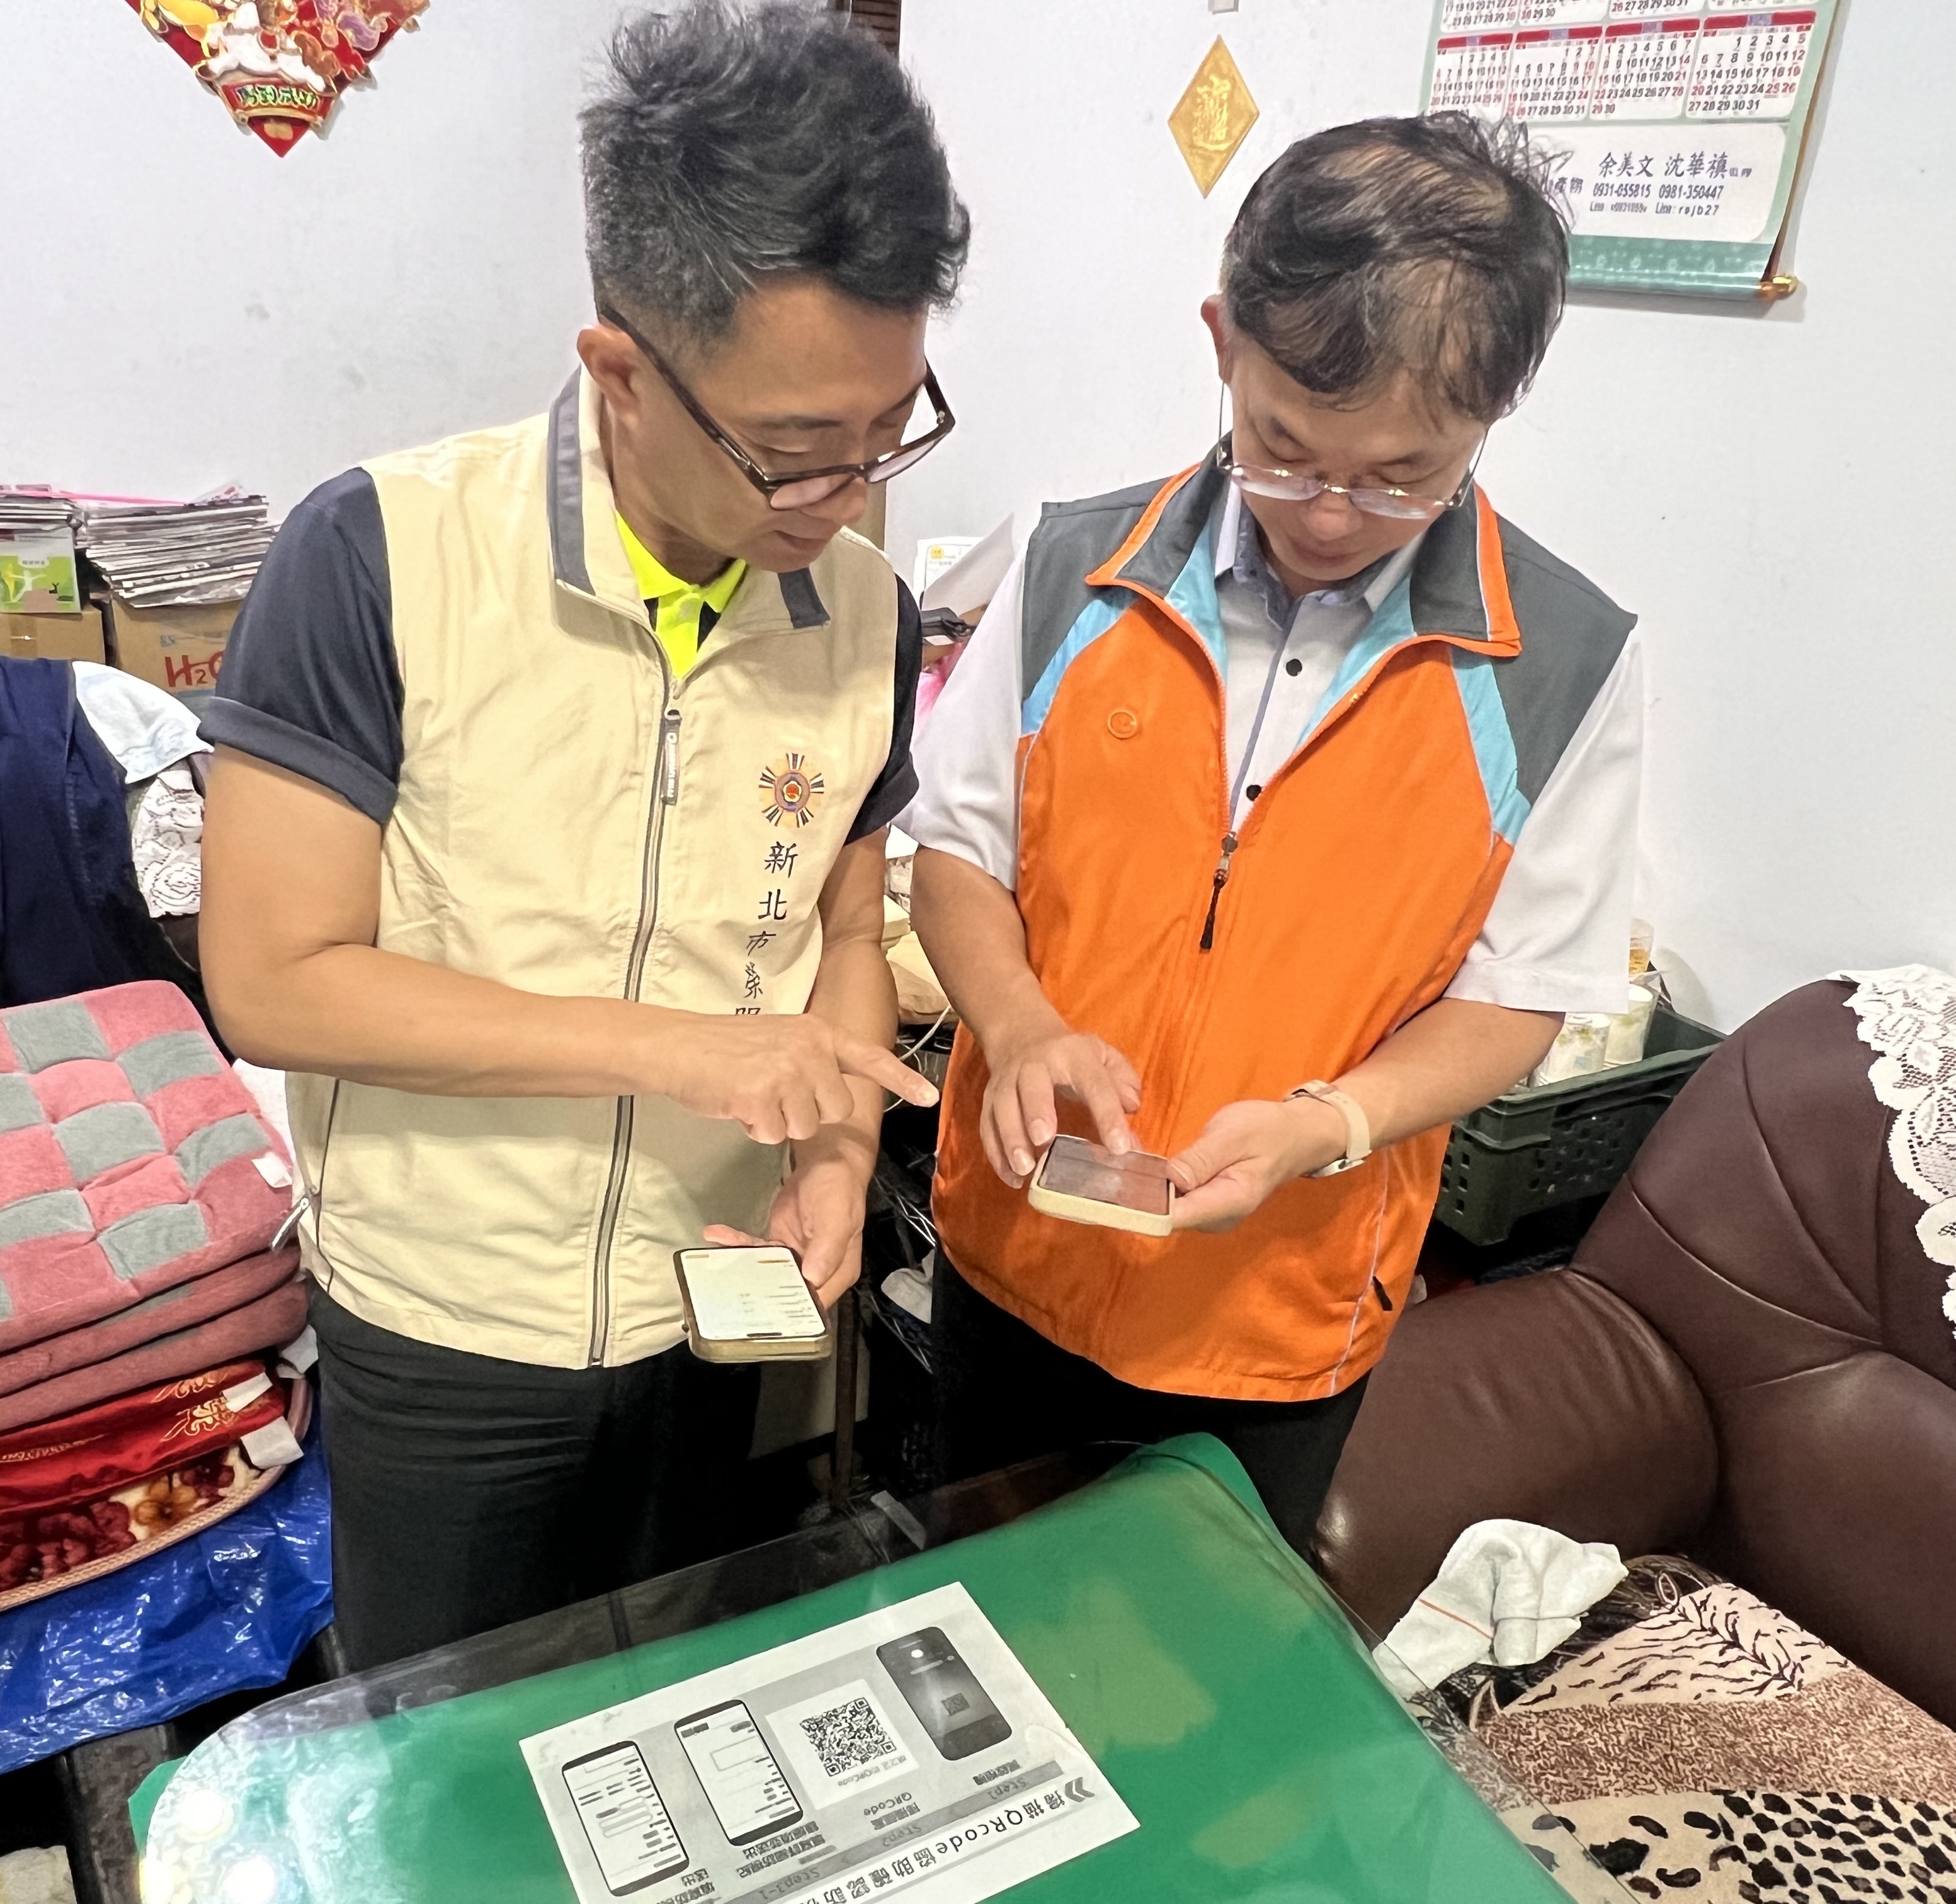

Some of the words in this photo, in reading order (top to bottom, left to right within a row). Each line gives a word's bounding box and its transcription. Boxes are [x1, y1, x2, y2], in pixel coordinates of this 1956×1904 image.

[1736, 36, 1742, 47] 1
[1749, 35, 1759, 46] 2
[1766, 35, 1774, 45] 3
[1782, 33, 1790, 43] 4
[1797, 32, 1807, 43] 5
[1701, 54, 1709, 64] 6
[1717, 53, 1724, 64] 7
[1730, 52, 1739, 63] 8
[1746, 52, 1754, 62] 9
[1760, 50, 1773, 62] 10
[1775, 50, 1789, 61] 11
[1792, 49, 1806, 60] 12
[1695, 69, 1708, 80] 13
[1710, 69, 1723, 79] 14
[1725, 68, 1739, 79] 15
[1740, 67, 1753, 78] 16
[1756, 67, 1770, 77] 17
[1691, 85, 1705, 96] 20
[1705, 84, 1719, 95] 21
[1719, 84, 1735, 94] 22
[1734, 83, 1749, 94] 23
[1749, 83, 1765, 94] 24
[1765, 82, 1781, 94] 25
[1781, 82, 1797, 93] 26
[1688, 100, 1702, 111] 27
[1702, 100, 1716, 111] 28
[1716, 99, 1731, 111] 29
[1731, 99, 1746, 110] 30
[1746, 99, 1761, 110] 31
